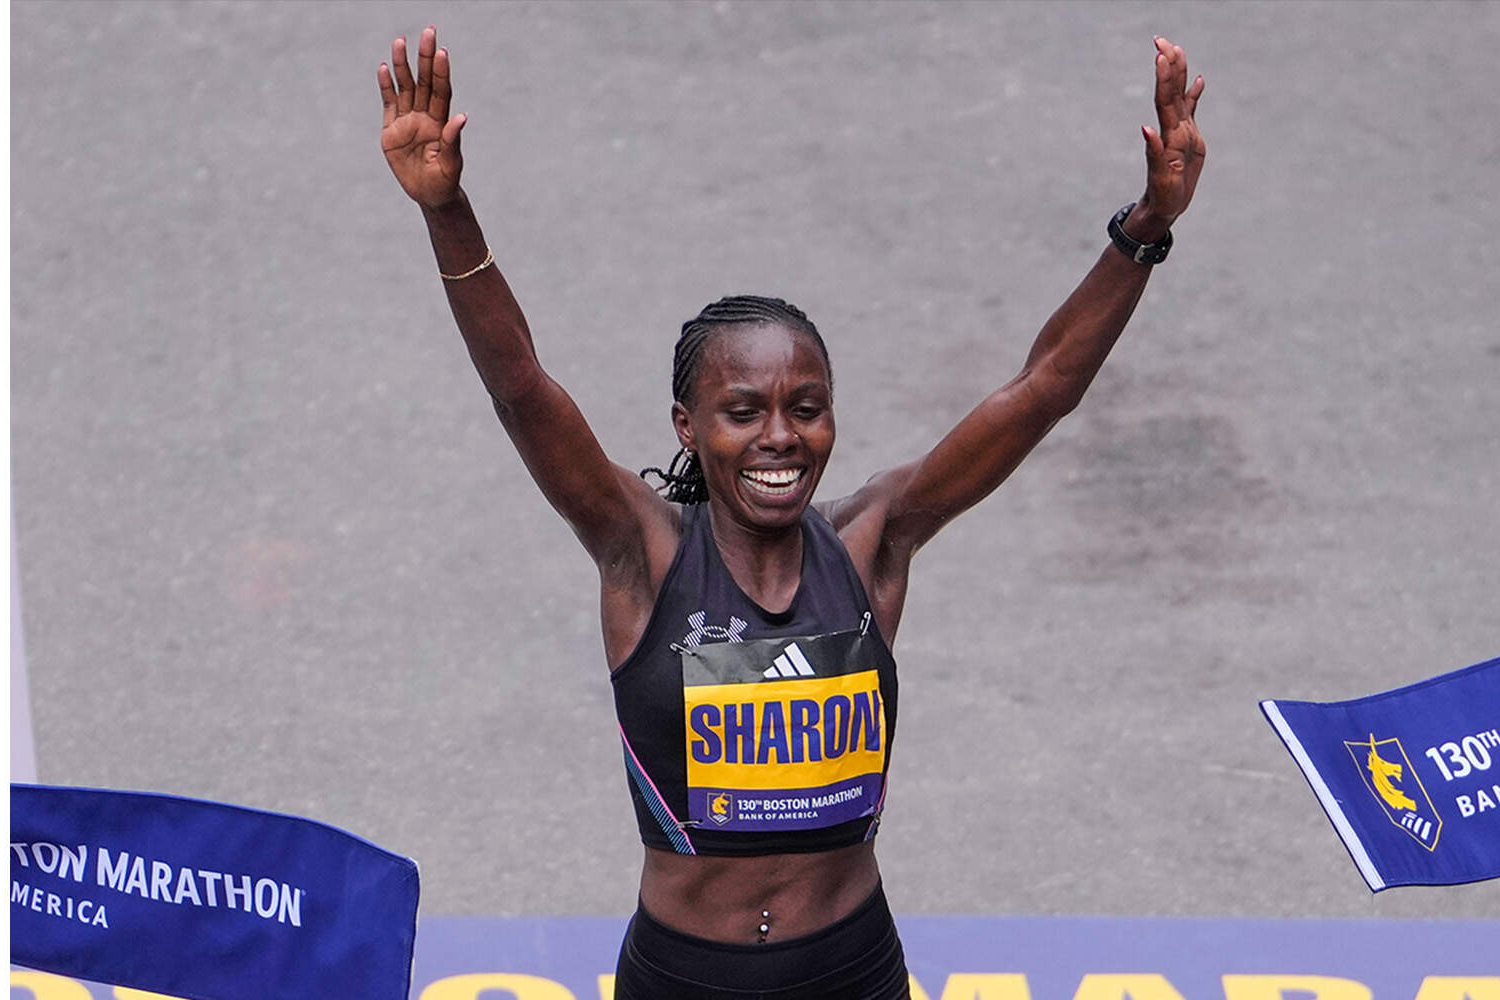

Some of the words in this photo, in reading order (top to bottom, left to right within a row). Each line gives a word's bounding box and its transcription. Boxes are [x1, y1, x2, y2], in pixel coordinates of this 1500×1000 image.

[690, 689, 882, 765] SHARON
[1425, 728, 1500, 782] 130TH
[738, 813, 763, 821] BANK
[764, 812, 777, 820] OF
[778, 810, 819, 820] AMERICA
[763, 798, 809, 811] BOSTON
[811, 786, 863, 808] MARATHON
[10, 880, 109, 929] MERICA
[97, 847, 302, 927] MARATHON
